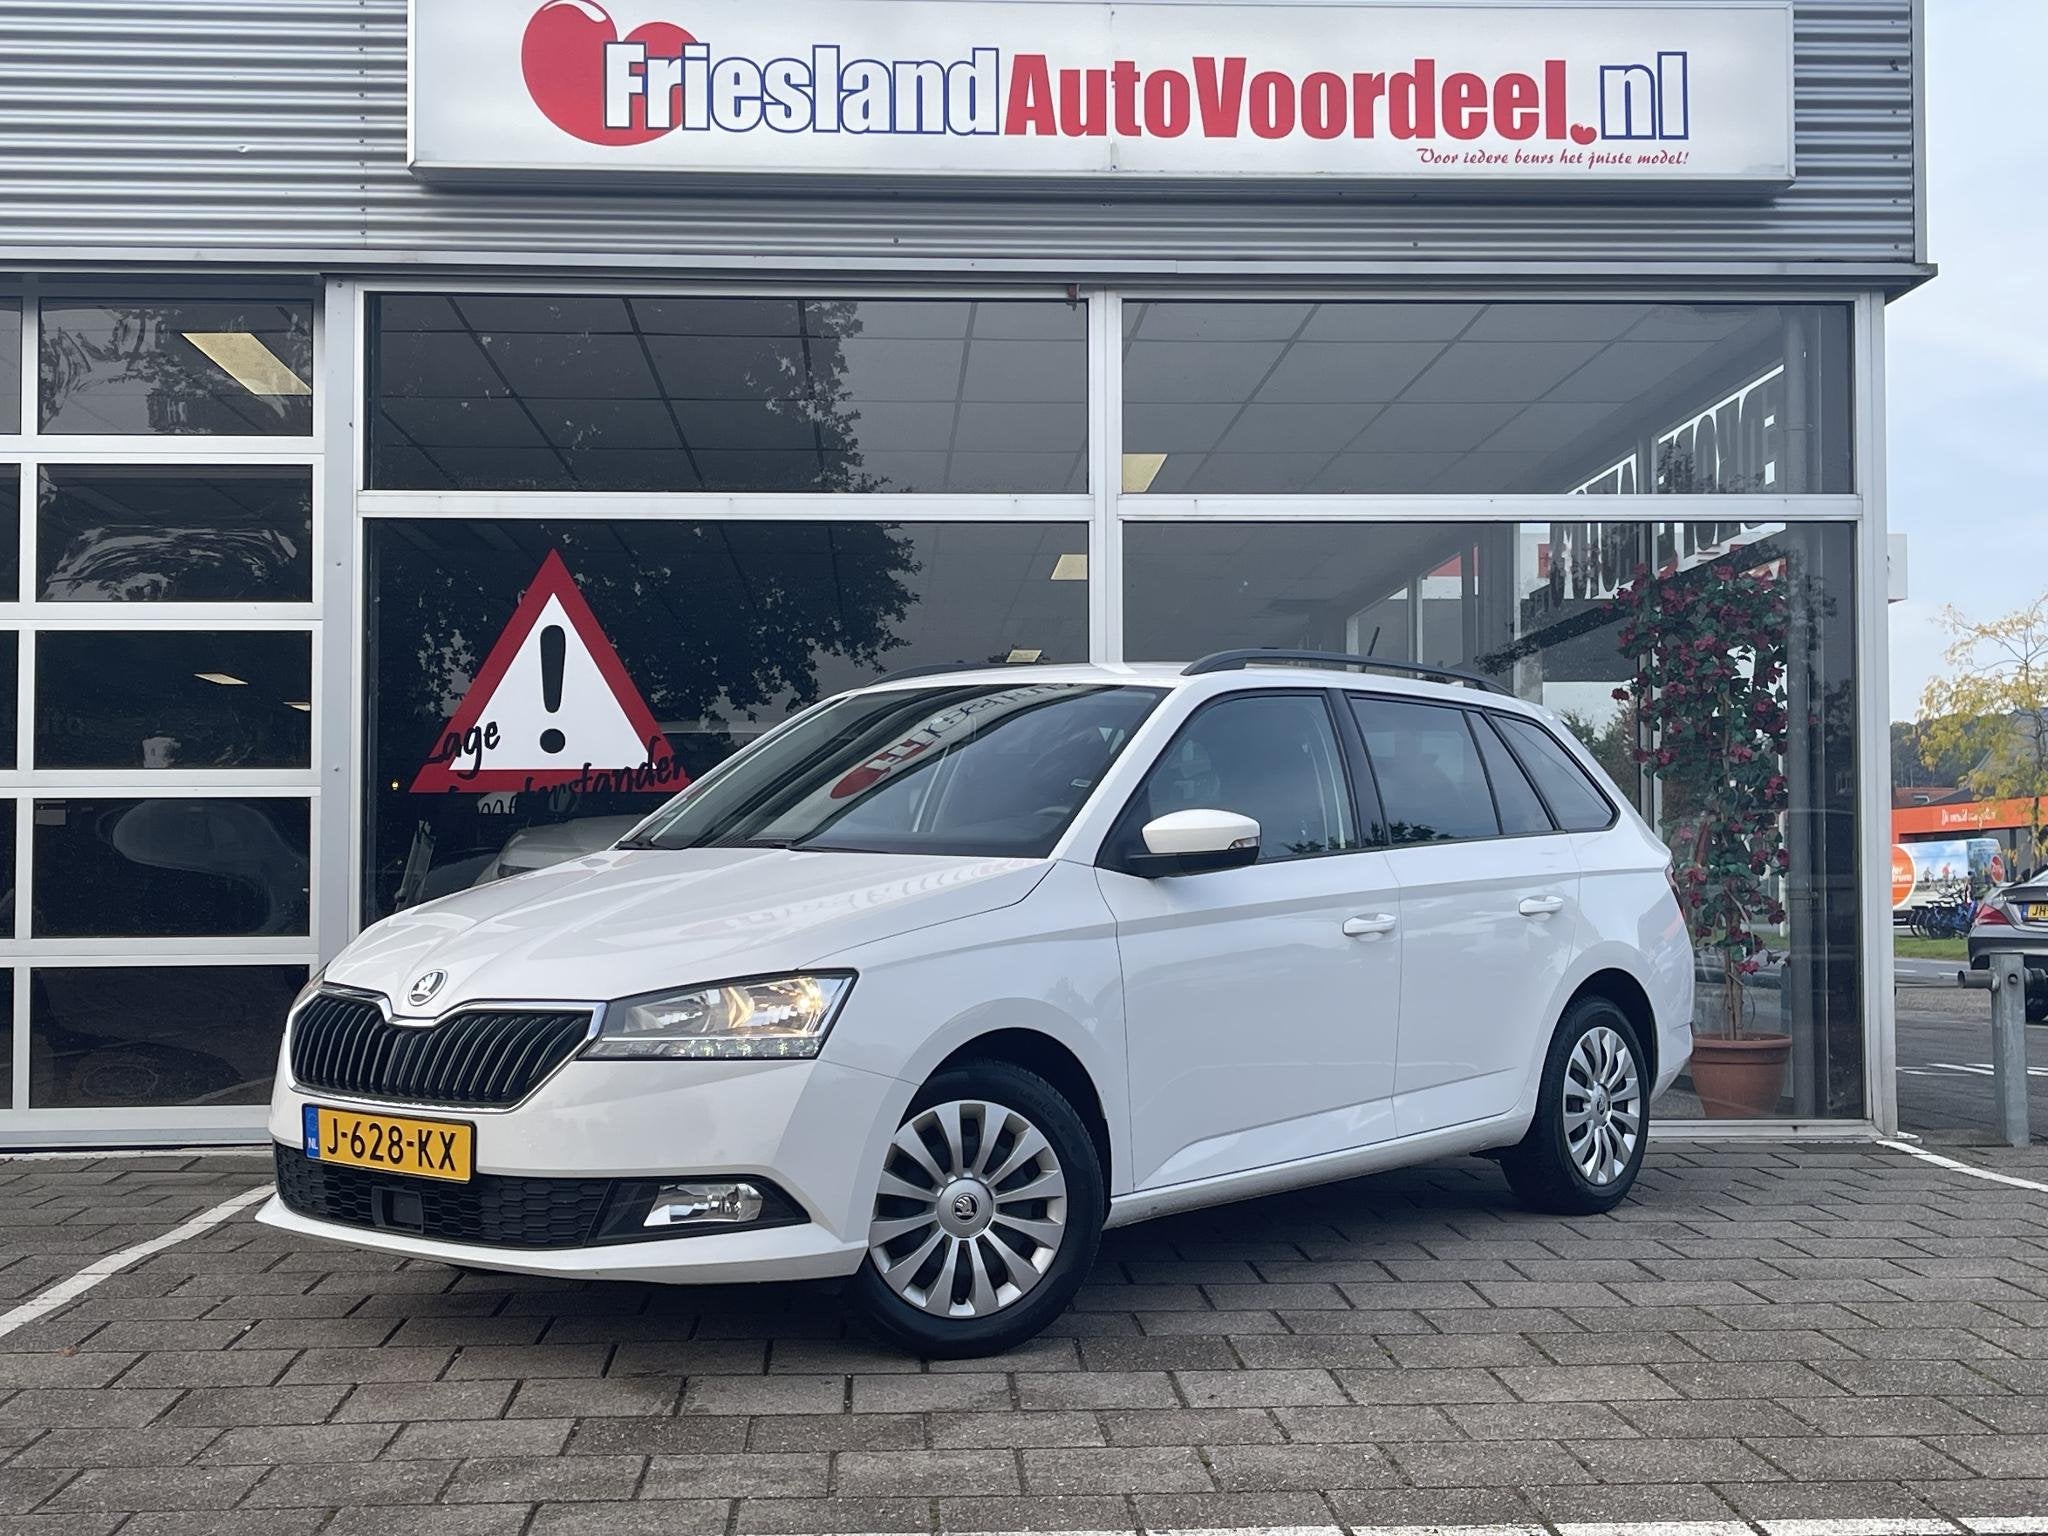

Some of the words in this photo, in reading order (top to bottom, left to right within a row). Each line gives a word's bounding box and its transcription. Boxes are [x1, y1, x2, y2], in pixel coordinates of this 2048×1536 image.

[1416, 147, 1459, 165] Voor
[1463, 149, 1510, 165] iedere
[1514, 148, 1555, 165] beurs
[1559, 148, 1583, 164] het
[1586, 151, 1633, 169] juiste
[1636, 149, 1690, 166] model!
[307, 1137, 319, 1151] NL
[327, 1117, 457, 1172] J-628-KX
